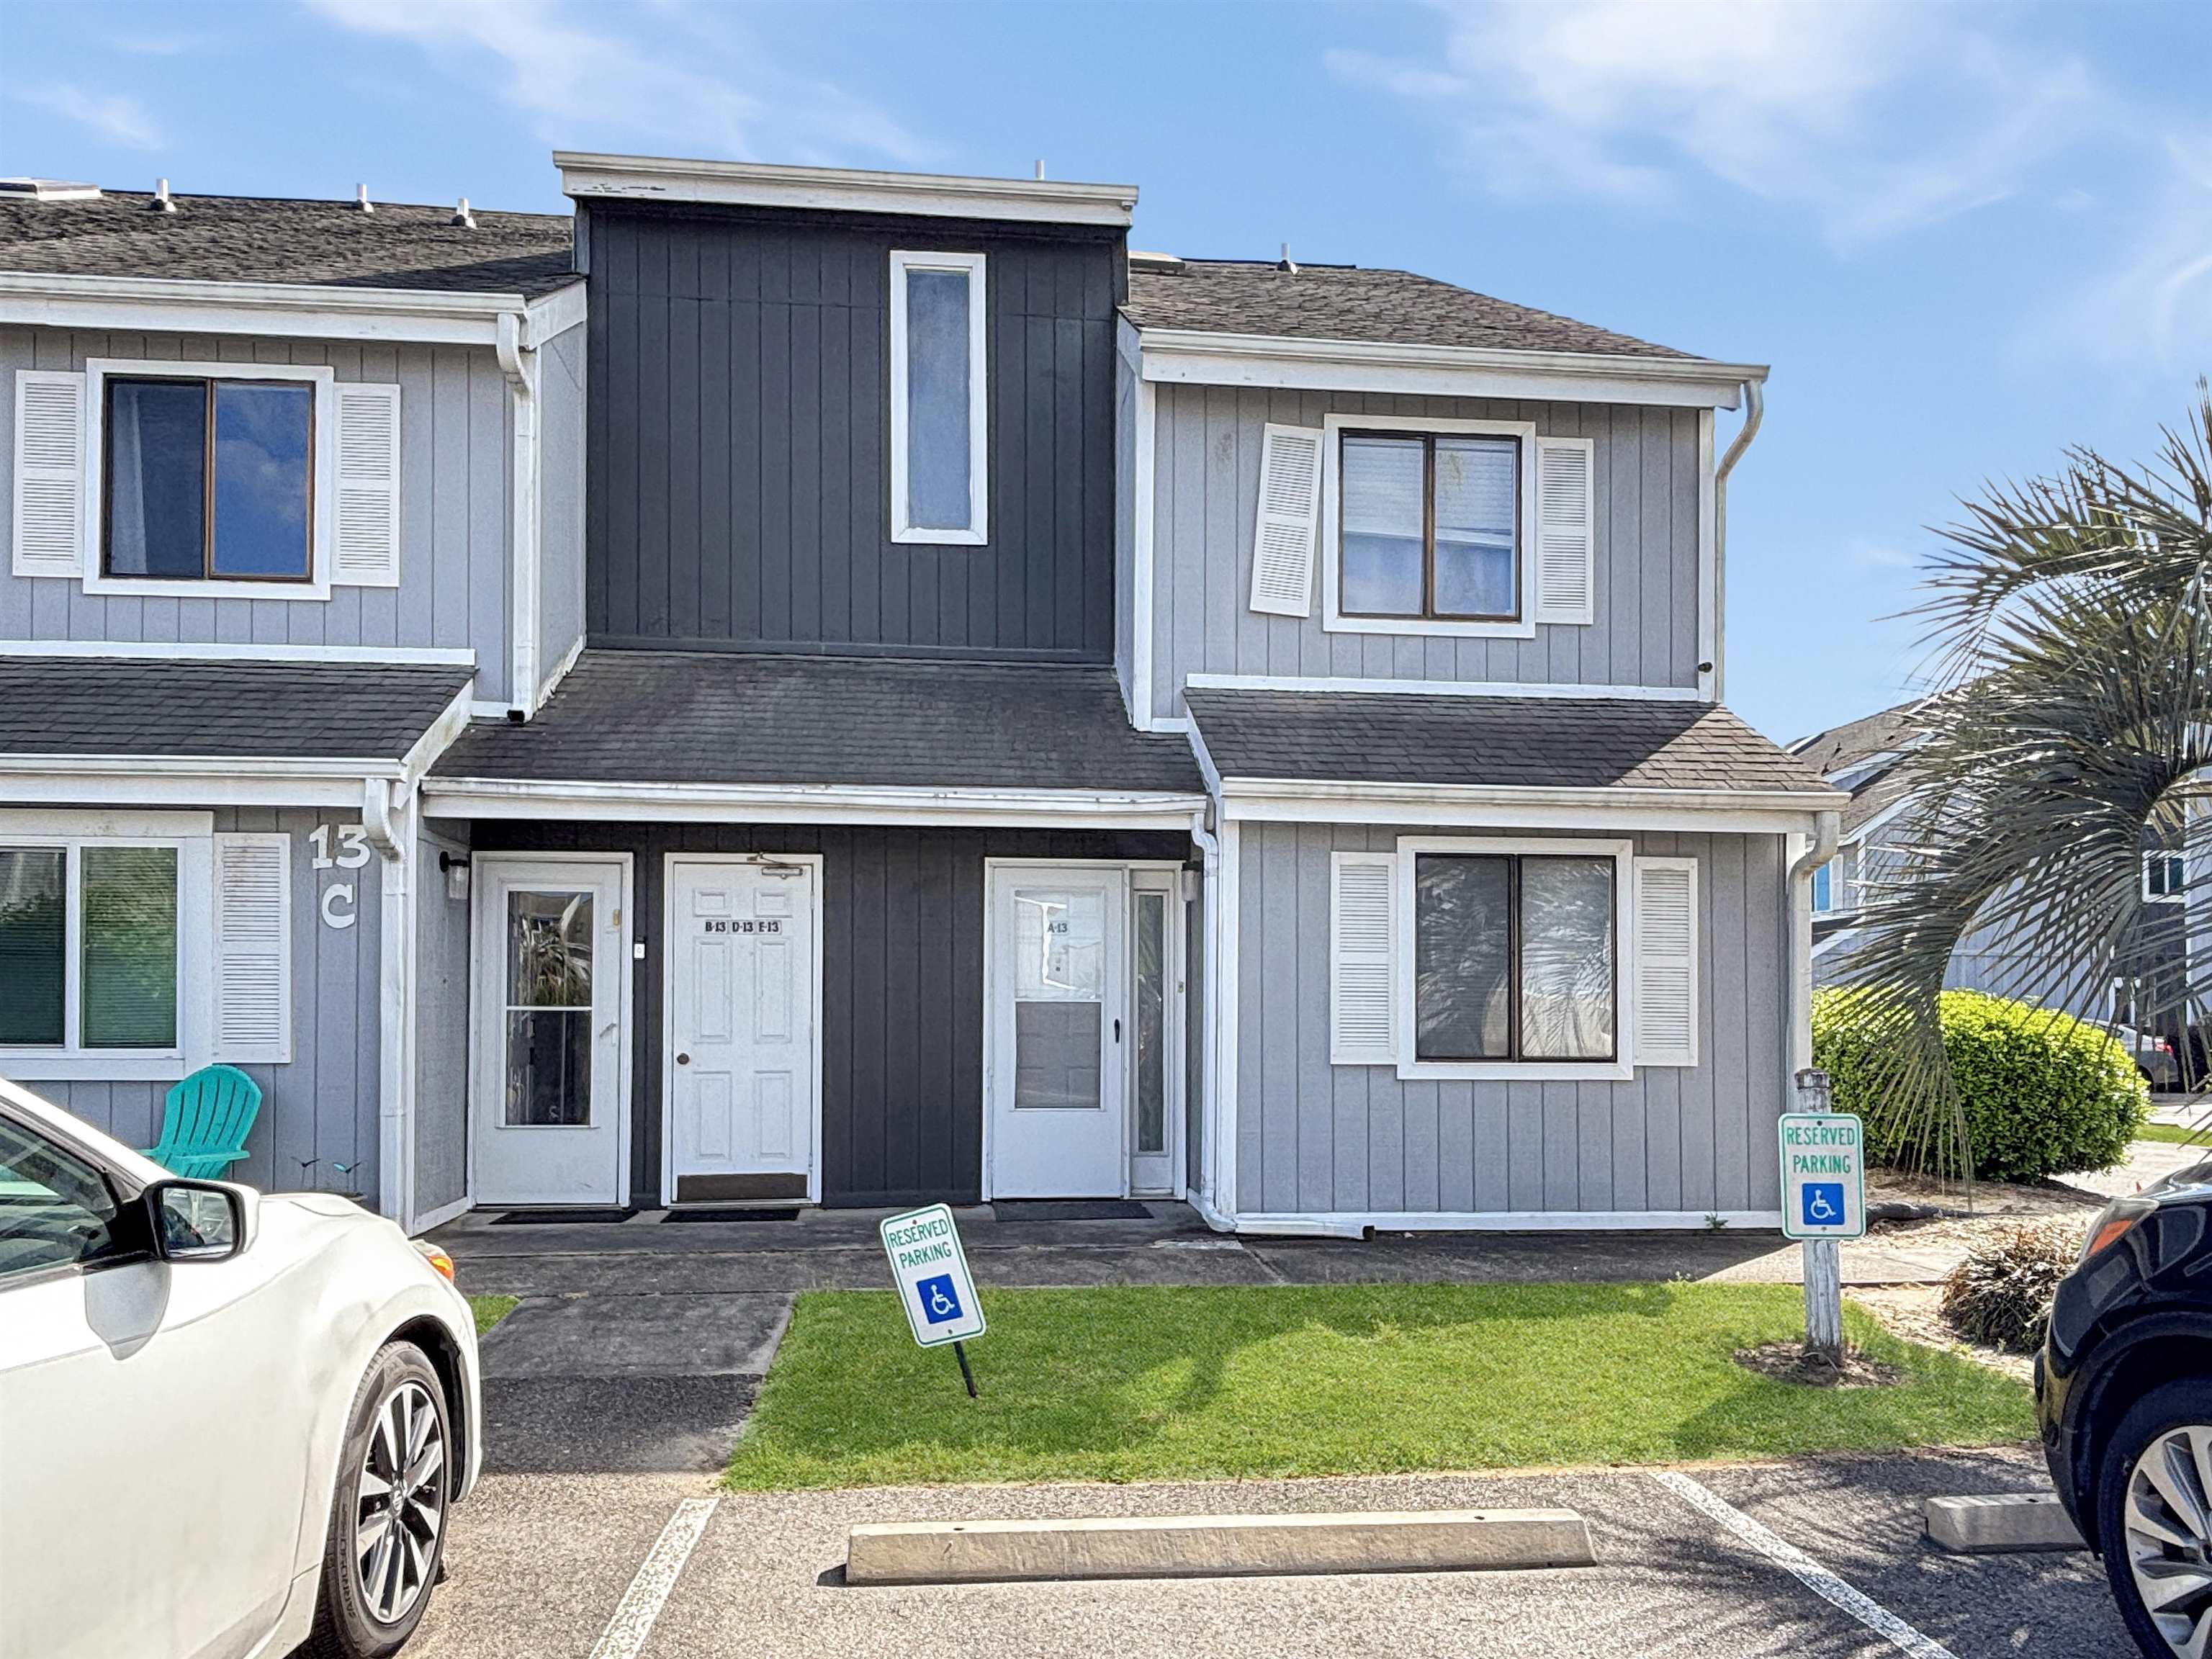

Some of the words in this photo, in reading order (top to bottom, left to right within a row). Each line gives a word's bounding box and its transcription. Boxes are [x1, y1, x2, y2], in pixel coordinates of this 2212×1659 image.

[309, 824, 371, 869] 13
[322, 884, 356, 928] C
[706, 921, 726, 932] B-13
[732, 922, 753, 932] D-13
[758, 922, 779, 932] E-13
[1047, 922, 1067, 933] A-13
[1786, 1127, 1855, 1146] RESERVED
[1793, 1155, 1851, 1174] PARKING
[889, 1218, 948, 1248] RESERVED
[899, 1241, 952, 1269] PARKING
